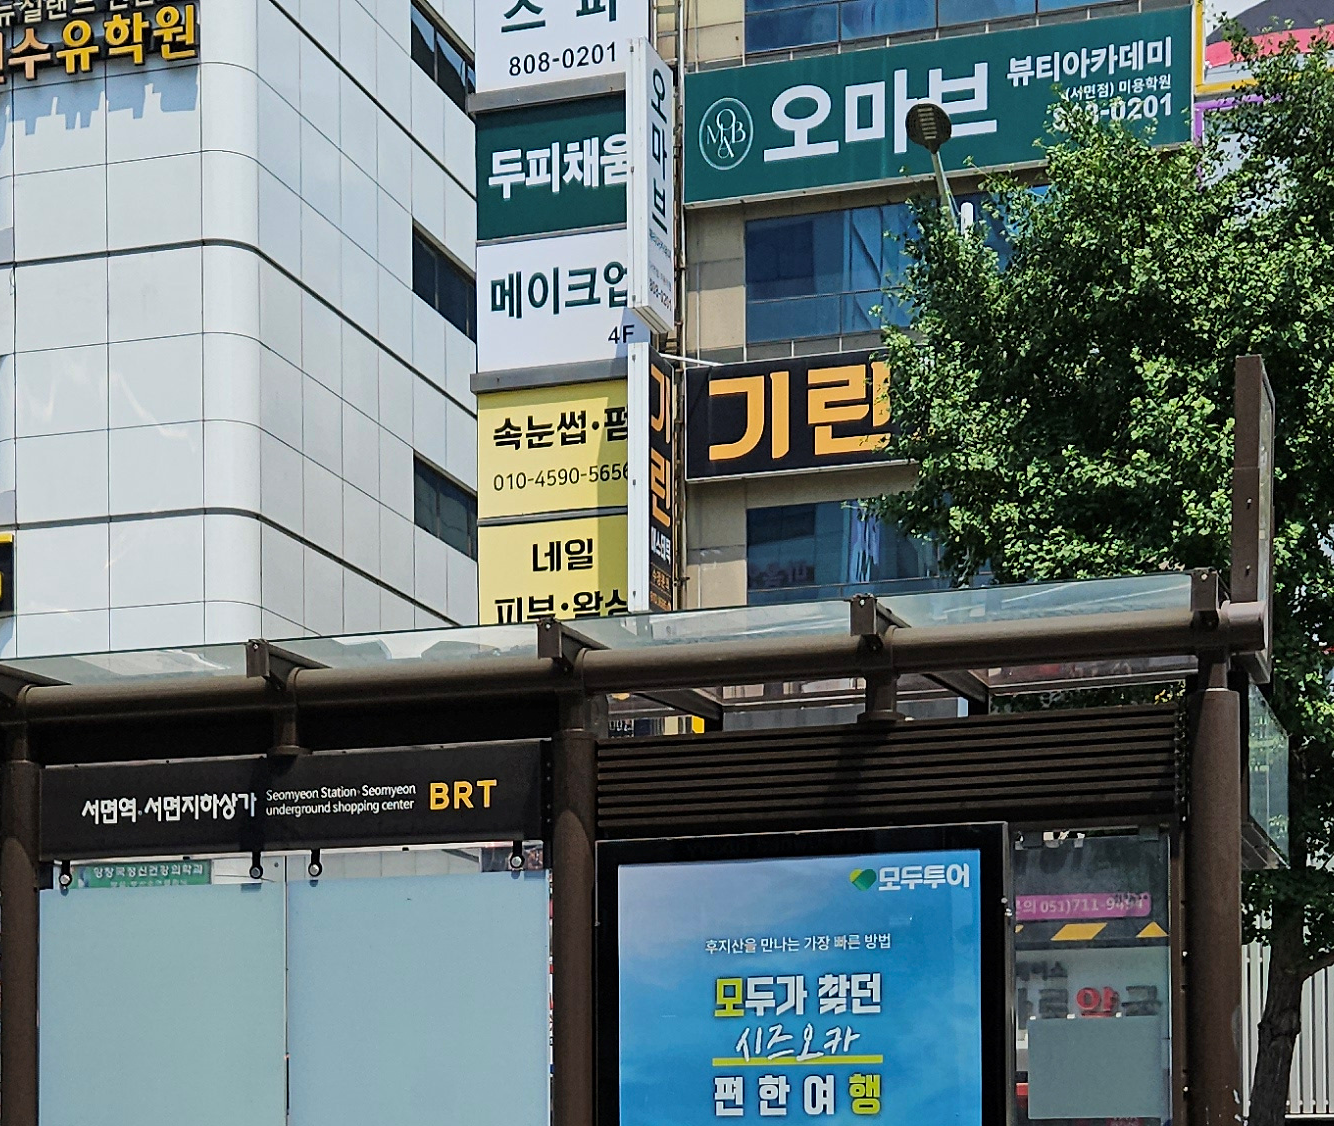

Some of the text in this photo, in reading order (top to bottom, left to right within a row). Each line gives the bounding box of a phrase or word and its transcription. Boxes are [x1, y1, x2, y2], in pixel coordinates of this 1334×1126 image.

[509, 41, 617, 76] 808-0201
[763, 62, 997, 162] 오마브
[1006, 36, 1172, 87] 뷰티아카데미
[1118, 73, 1172, 94] 미용학원
[488, 133, 627, 200] 두피채움
[651, 68, 668, 234] 오마브
[490, 261, 627, 319] 메이크업
[607, 324, 635, 344] 4F
[708, 360, 892, 461] 기린
[650, 363, 671, 528] 기린
[532, 538, 593, 572] 네일
[265, 789, 319, 803] Seomyeon
[361, 784, 416, 799] Seomyeon
[265, 799, 415, 818] underground shopping center
[429, 779, 498, 811] BRT
[878, 863, 970, 892] 모두투어
[705, 933, 891, 955] 후지산을 만나는 가장 빠른 방법
[714, 973, 882, 1017] 모두가 찾던
[735, 1022, 861, 1063] 시즈오카
